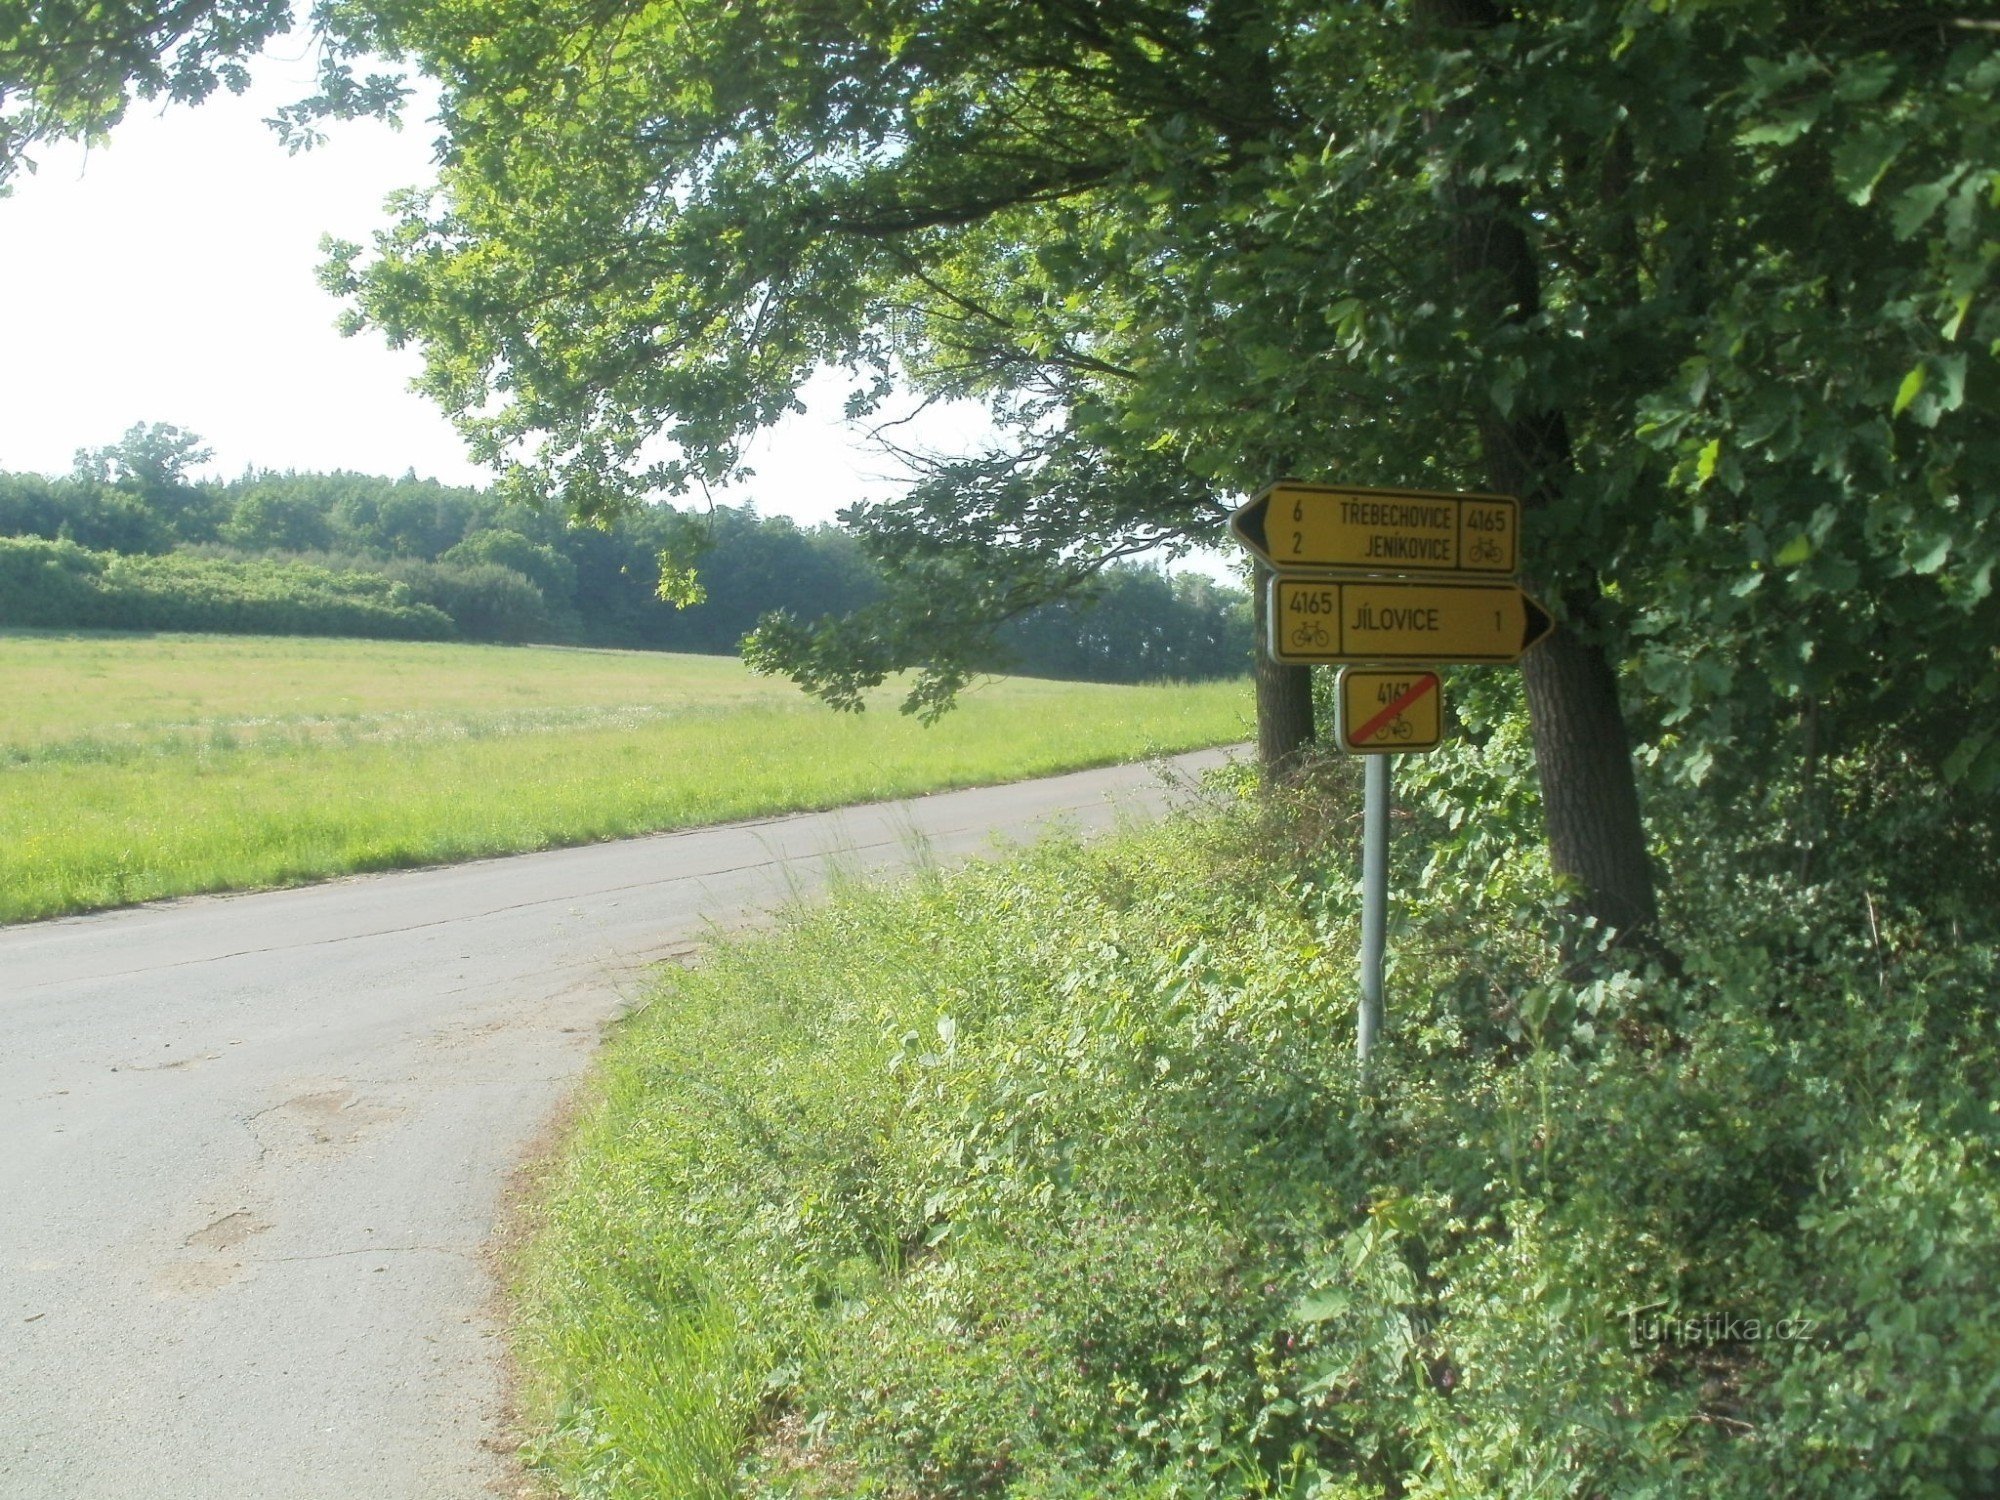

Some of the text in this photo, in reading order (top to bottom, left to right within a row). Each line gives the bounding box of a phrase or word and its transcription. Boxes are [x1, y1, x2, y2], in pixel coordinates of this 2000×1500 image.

[1292, 497, 1452, 530] 6 TŘEBECHOVICE
[1467, 509, 1506, 532] 4165
[1292, 531, 1451, 561] 2 JENÍKOVICE
[1289, 591, 1332, 614] 4165
[1351, 603, 1501, 632] JÍLOVICE 1
